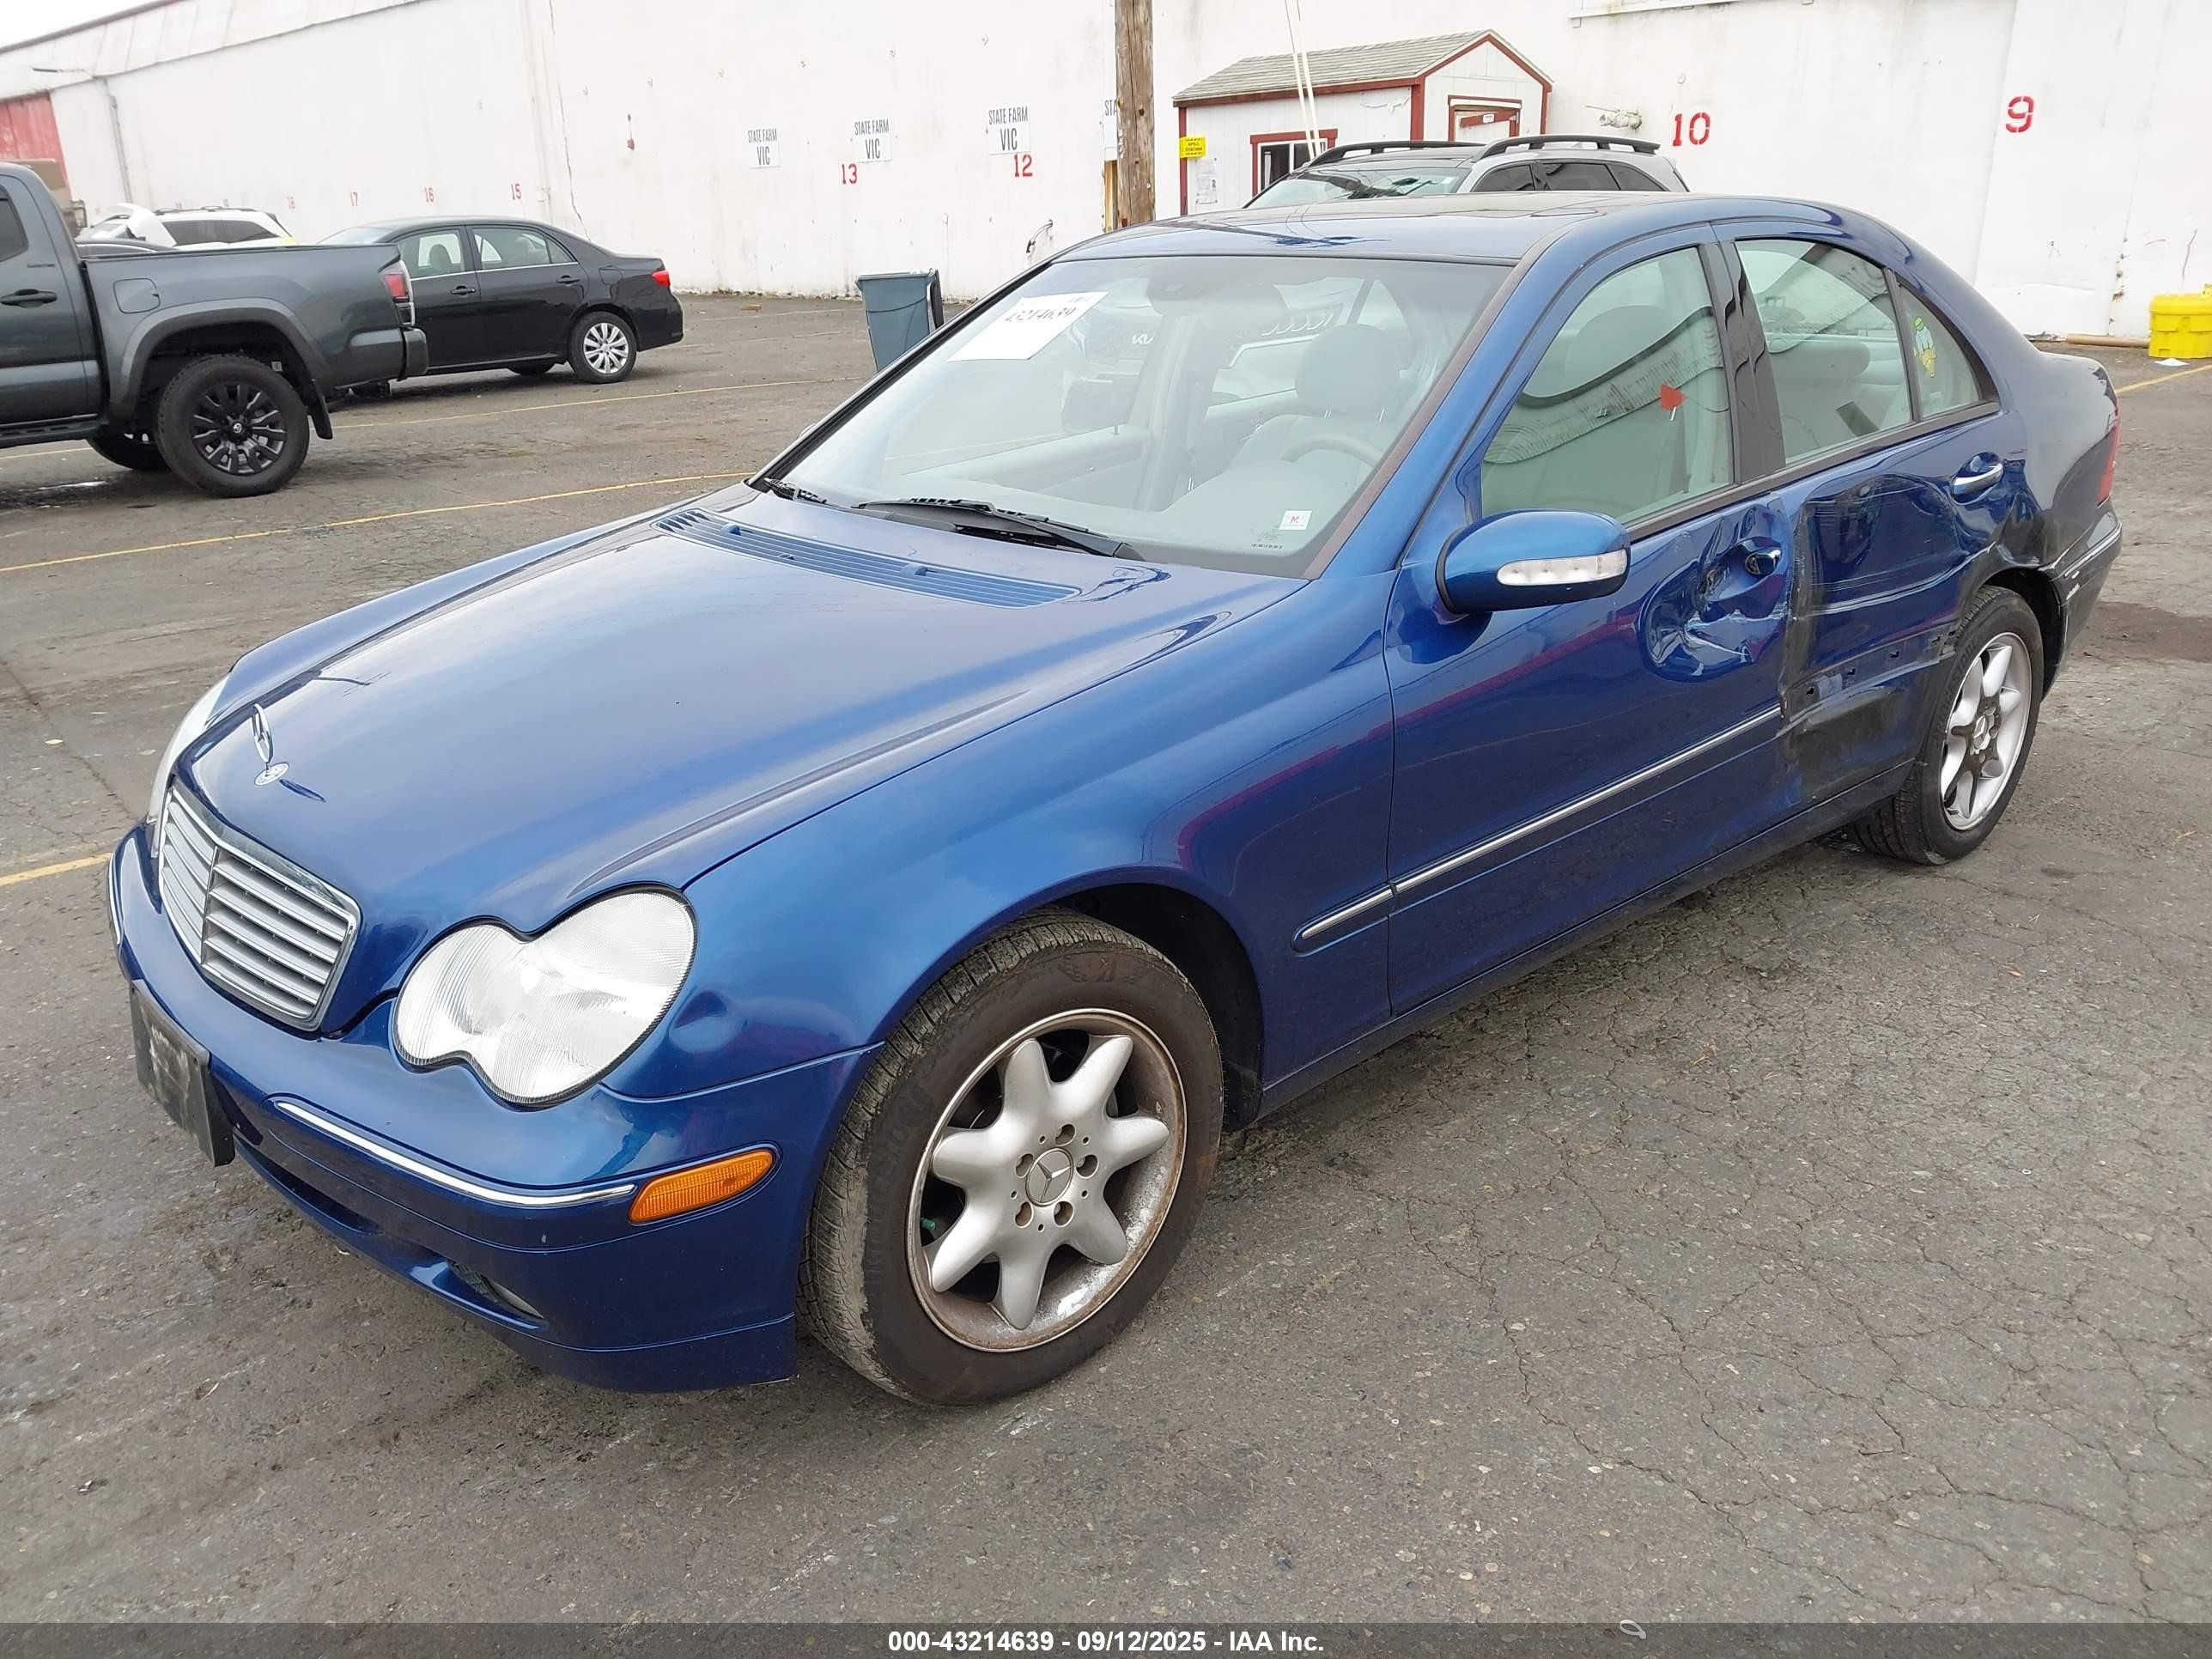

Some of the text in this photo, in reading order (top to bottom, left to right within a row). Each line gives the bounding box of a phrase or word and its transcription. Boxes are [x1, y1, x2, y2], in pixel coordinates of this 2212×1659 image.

[988, 106, 1029, 125] STATE FARM
[1104, 99, 1118, 117] STA
[2005, 95, 2035, 133] 9
[747, 128, 778, 143] STATE FARM
[854, 118, 890, 137] STATE FARM
[1672, 112, 1711, 147] 10
[865, 137, 881, 160] VIC
[1000, 127, 1018, 151] VIC
[757, 145, 771, 166] VIC
[1013, 153, 1033, 178] 12
[841, 162, 858, 185] 13
[349, 191, 359, 208] 17
[510, 183, 522, 201] 15
